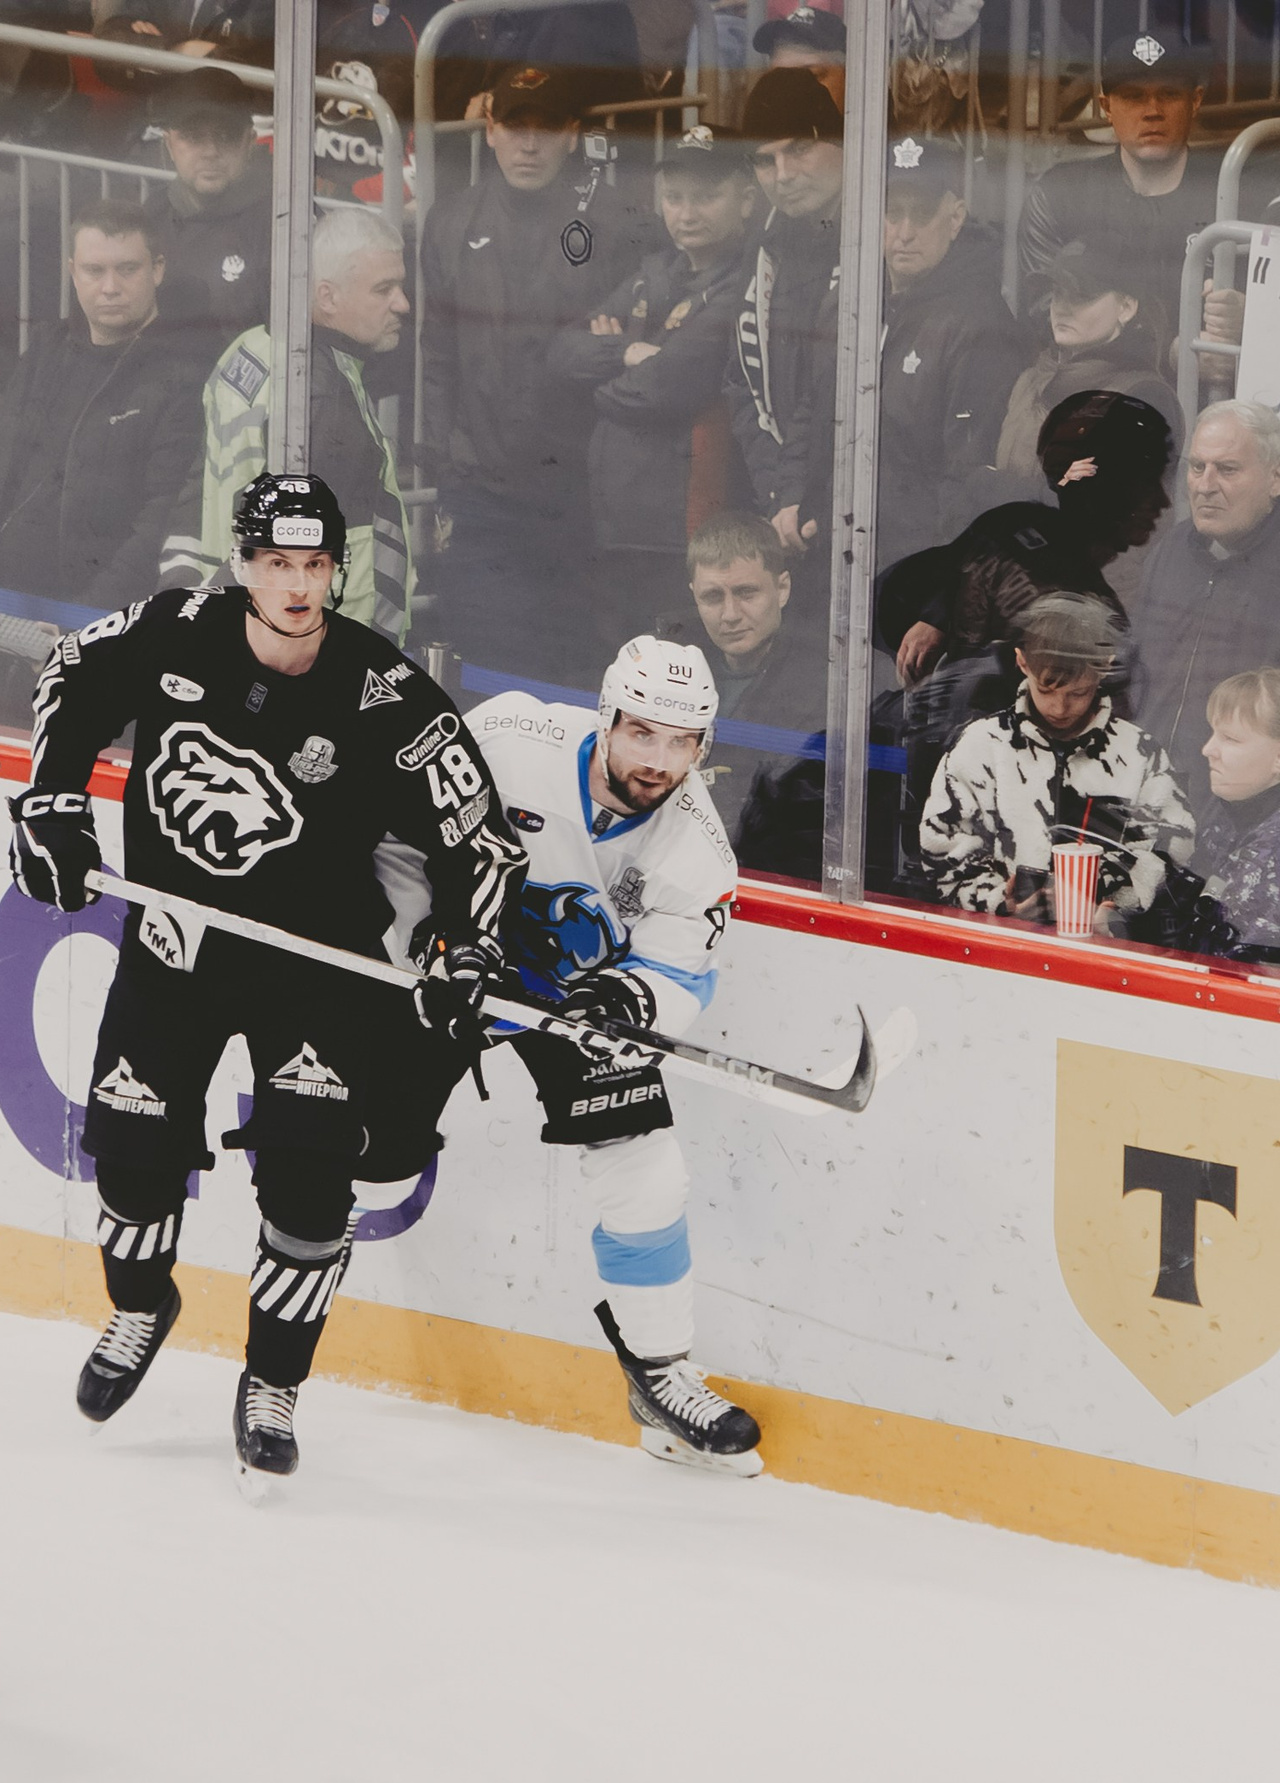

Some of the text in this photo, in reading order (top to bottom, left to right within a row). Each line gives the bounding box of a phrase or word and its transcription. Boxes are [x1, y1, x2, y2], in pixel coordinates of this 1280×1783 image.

[276, 526, 320, 538] согаз
[653, 696, 696, 713] согаз
[483, 714, 565, 741] Belavia
[402, 730, 442, 766] Winline
[426, 744, 483, 810] 48
[21, 793, 91, 818] CC
[675, 793, 733, 864] Belavia
[538, 1016, 666, 1068] CCM
[295, 1080, 349, 1101] ИНТЕРПОЛ
[570, 1083, 663, 1117] BAUER
[111, 1096, 166, 1116] ИНТЕРПОЛ
